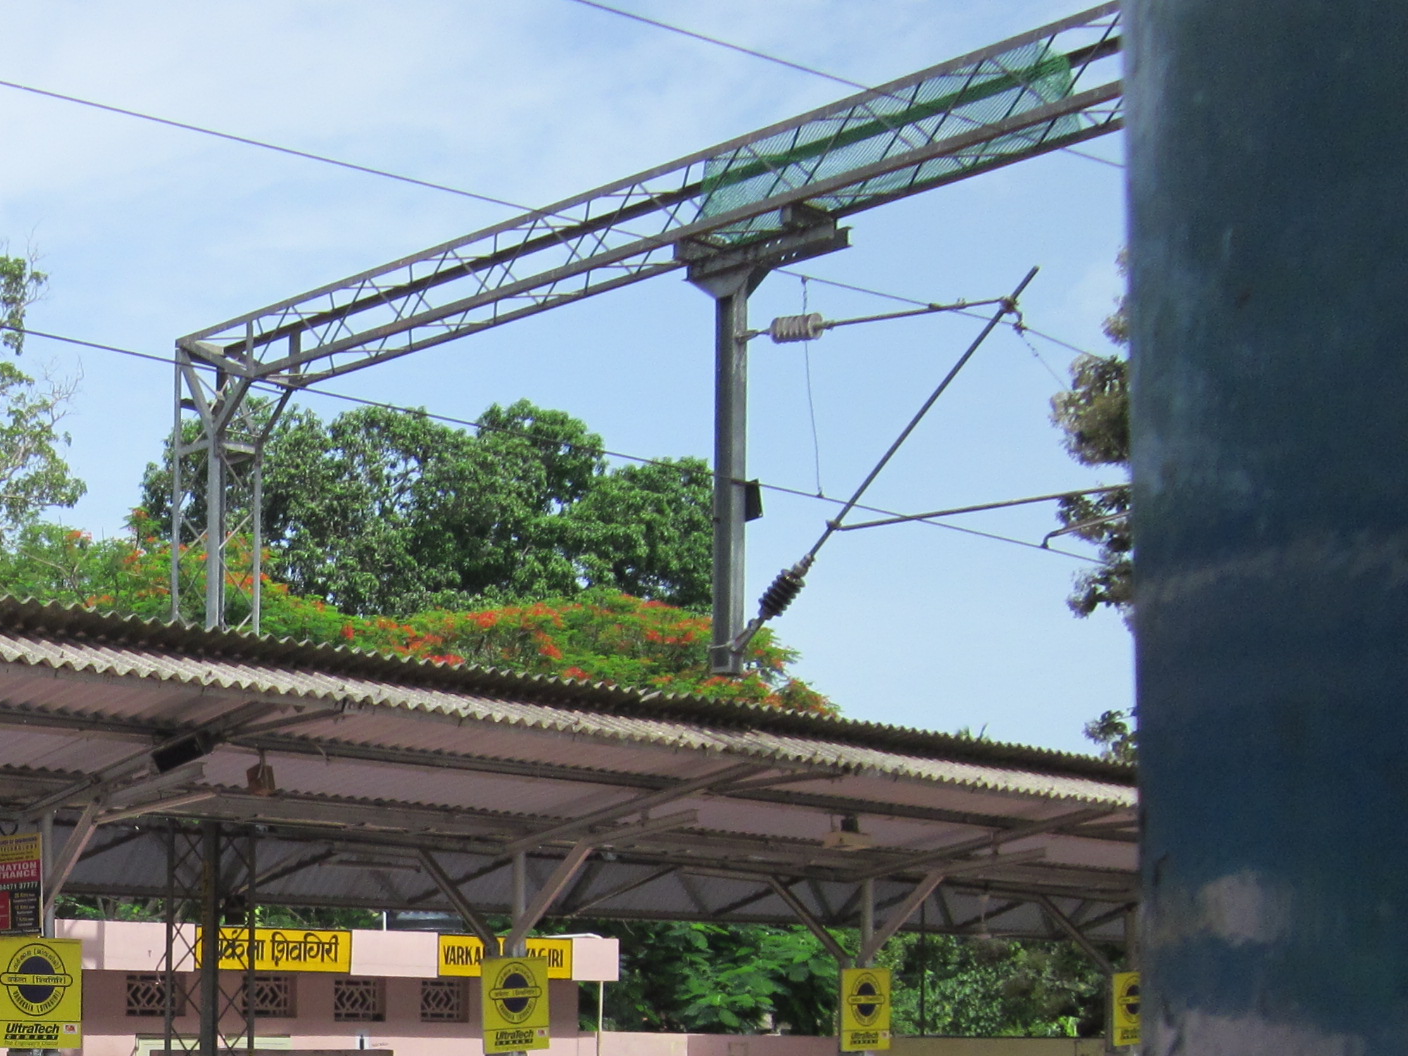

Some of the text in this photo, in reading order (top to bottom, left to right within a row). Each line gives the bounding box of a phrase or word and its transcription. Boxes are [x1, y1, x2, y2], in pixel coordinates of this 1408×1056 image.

[443, 945, 486, 966] VARKA
[5, 1022, 60, 1034] UltraTech
[495, 1029, 534, 1041] UltraTech
